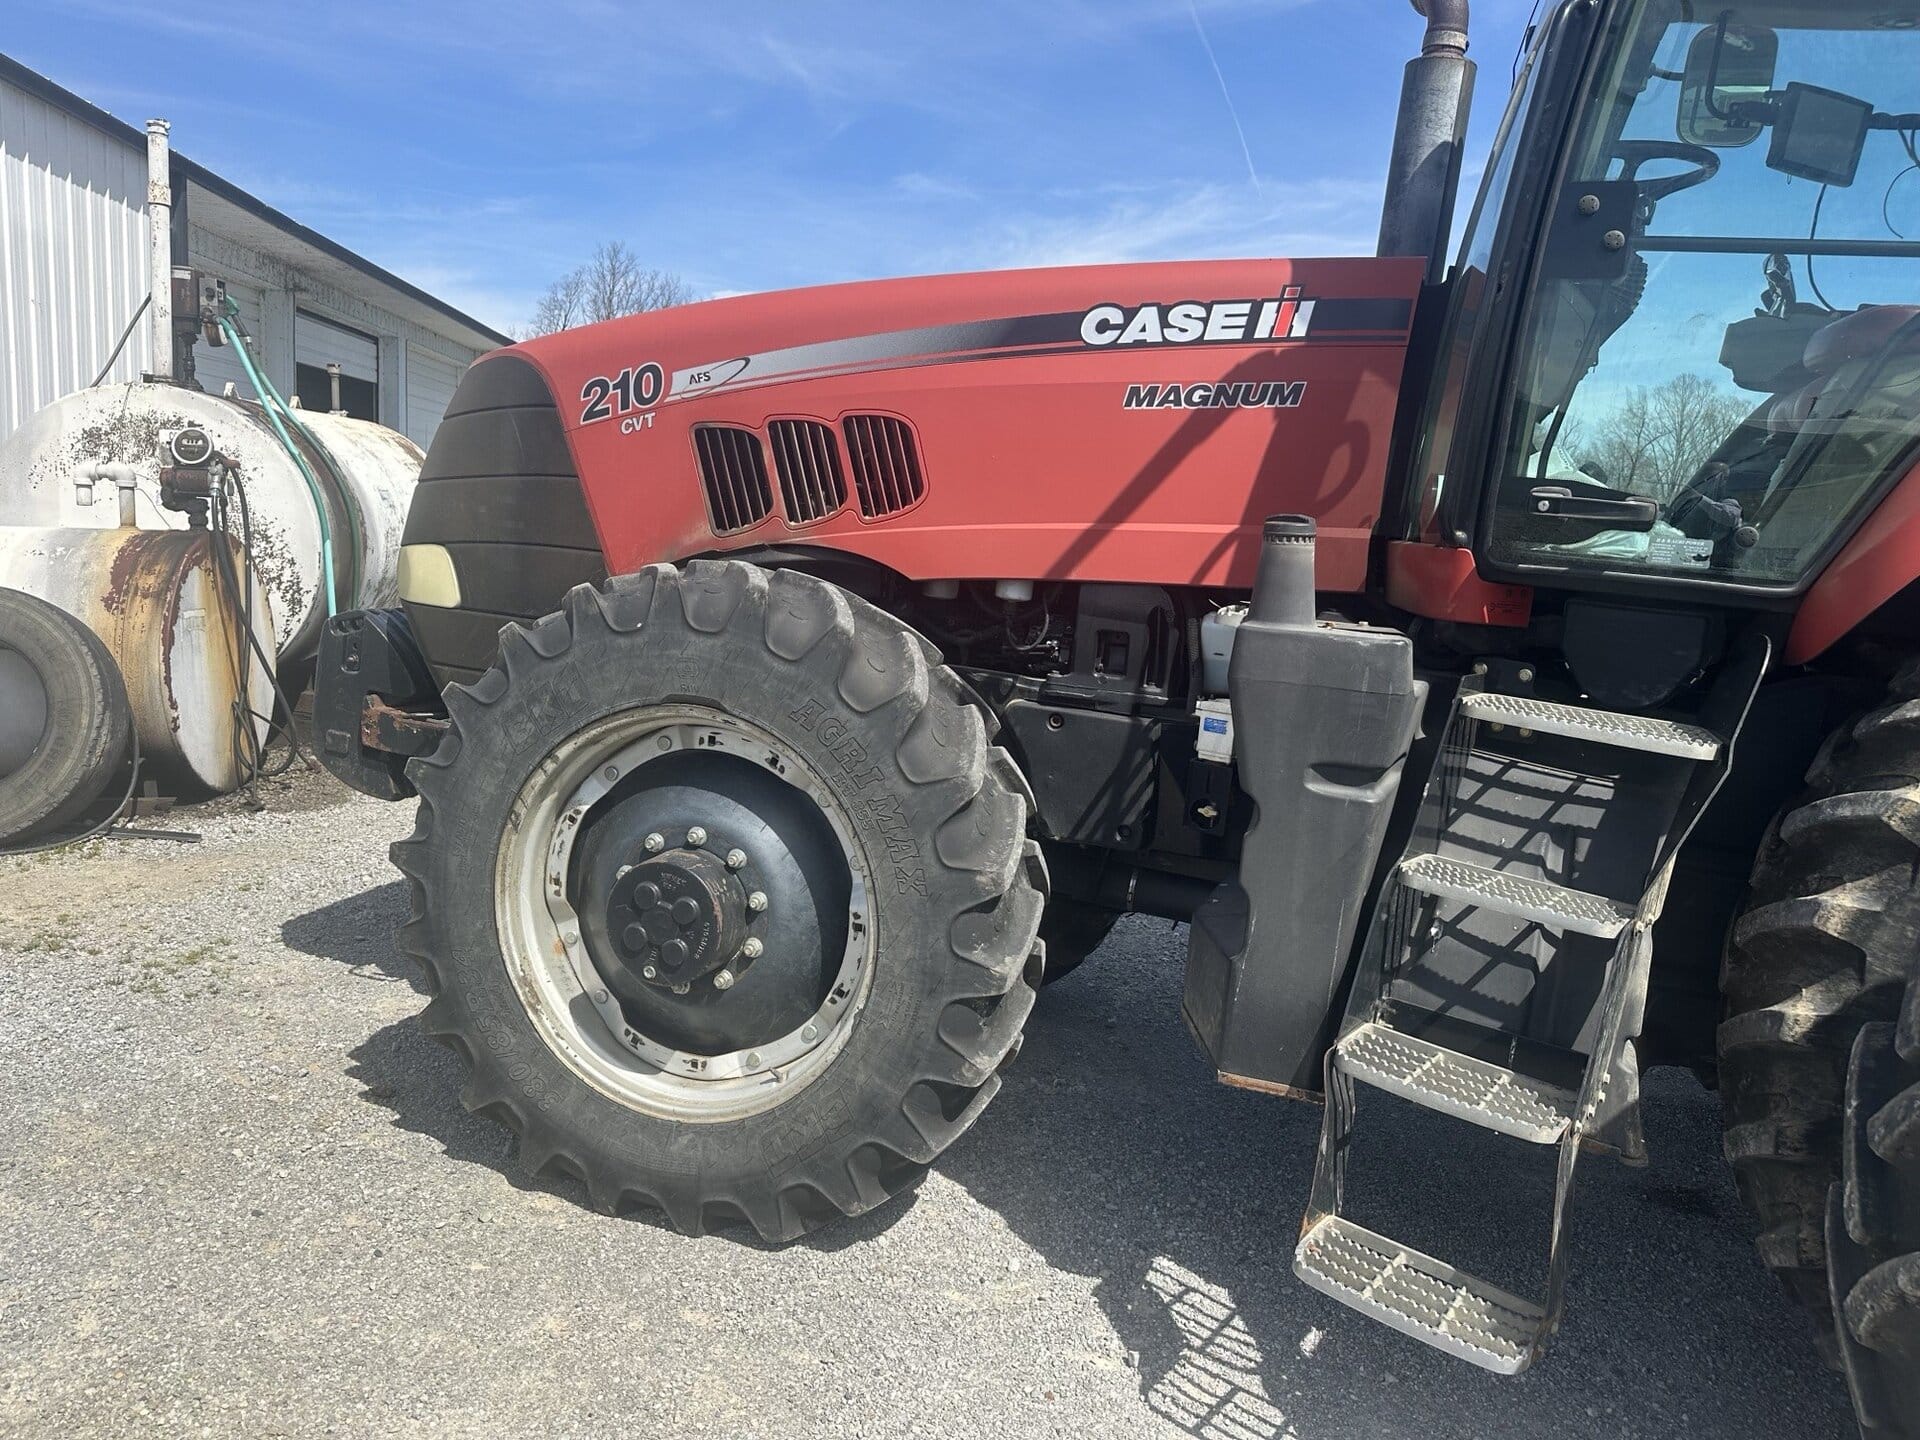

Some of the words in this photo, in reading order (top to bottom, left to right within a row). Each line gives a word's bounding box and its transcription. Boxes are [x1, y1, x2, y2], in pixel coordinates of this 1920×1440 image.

[1080, 301, 1252, 345] CASE
[580, 361, 664, 425] 210
[688, 371, 712, 385] AFS
[1123, 381, 1307, 410] MAGNUM
[620, 412, 656, 435] CVT
[788, 698, 886, 790] AGRI
[867, 794, 929, 897] MAX
